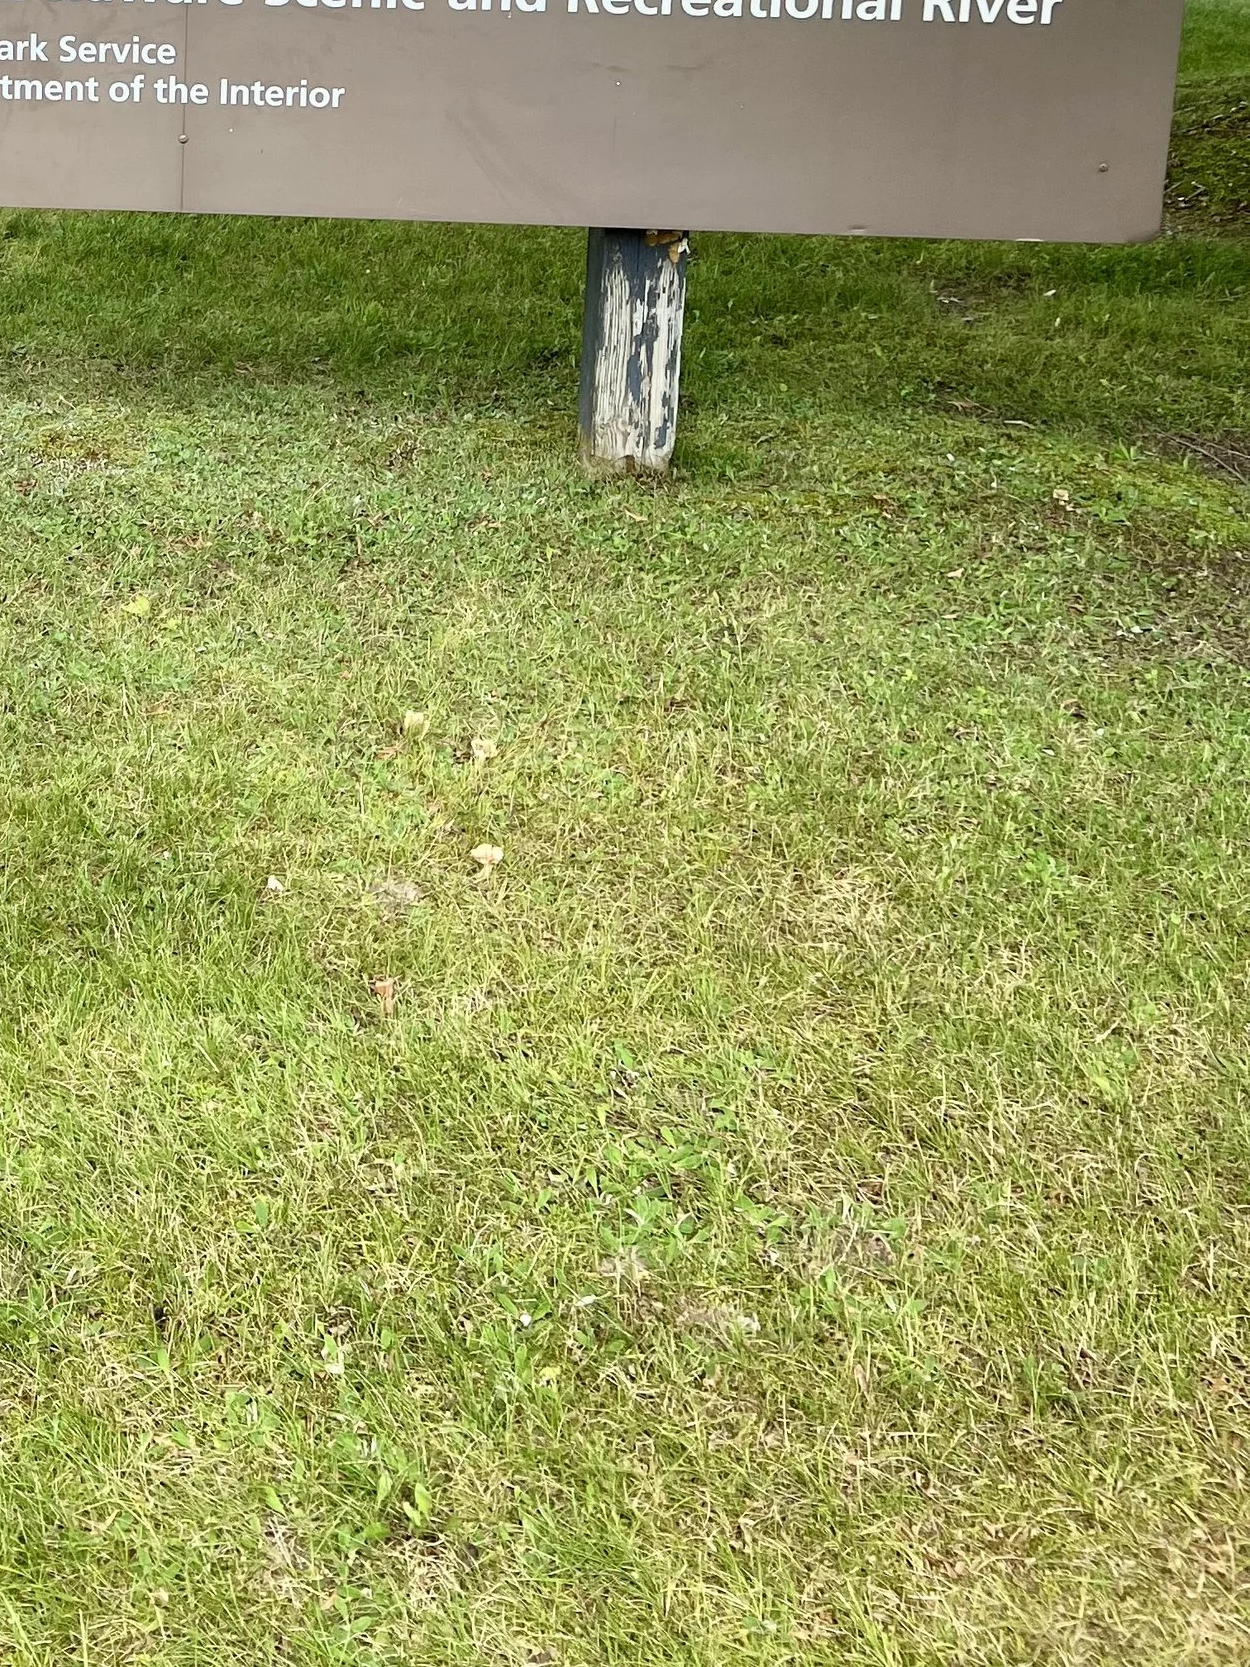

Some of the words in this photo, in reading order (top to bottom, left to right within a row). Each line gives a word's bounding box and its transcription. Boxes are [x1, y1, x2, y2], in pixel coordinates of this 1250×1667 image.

[59, 35, 177, 65] Service
[108, 74, 145, 103] of
[152, 75, 209, 105] the
[219, 78, 346, 108] Interior
